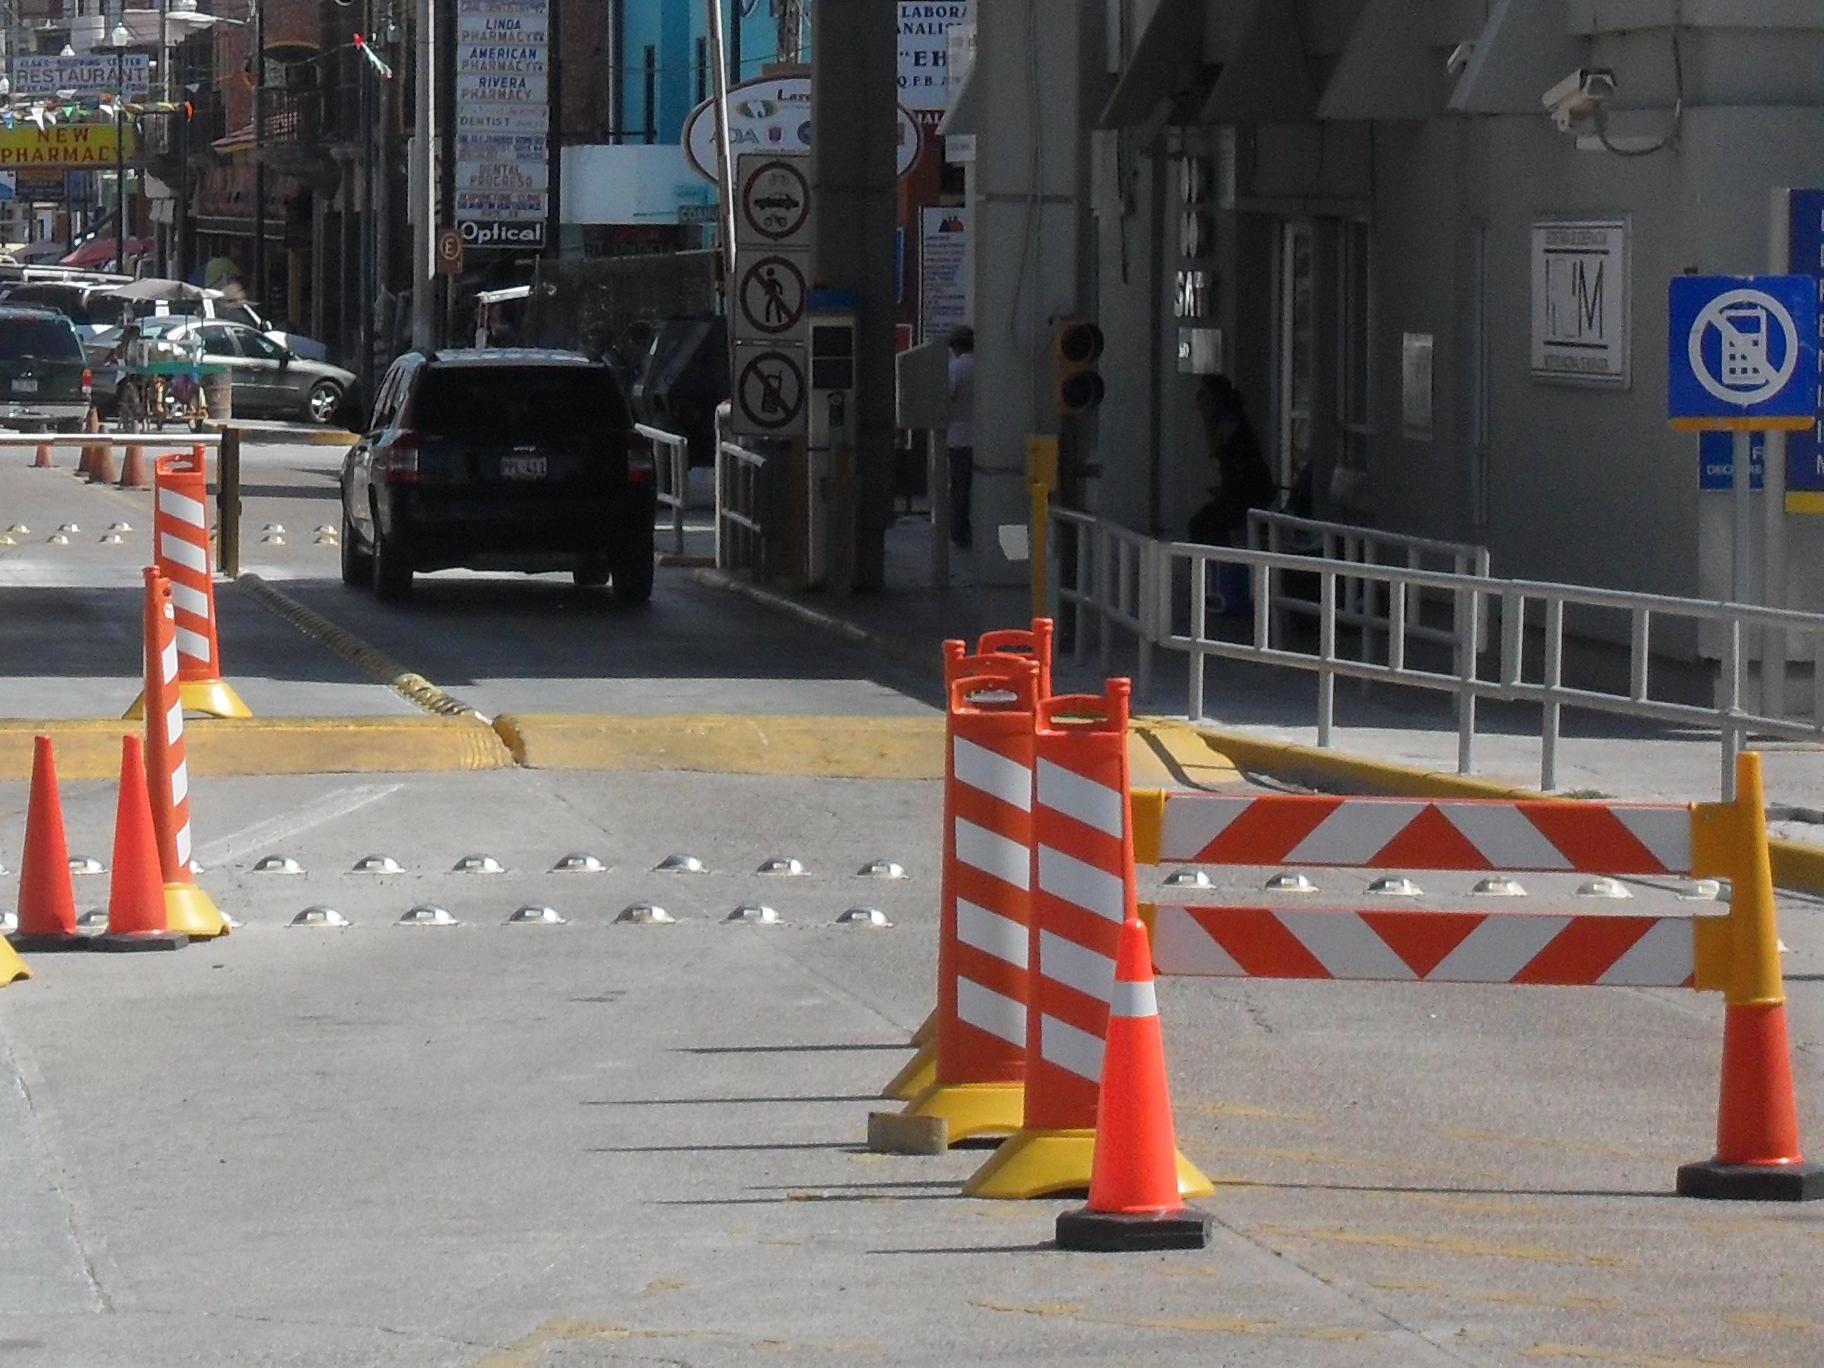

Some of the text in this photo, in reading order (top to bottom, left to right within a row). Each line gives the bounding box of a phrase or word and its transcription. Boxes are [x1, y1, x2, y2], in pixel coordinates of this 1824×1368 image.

[485, 18, 522, 31] LINDA
[461, 31, 532, 42] PHARMACY
[469, 47, 537, 59] AMERICAN
[461, 61, 532, 72] PHARMACY
[16, 67, 145, 83] RESTAURANT
[478, 77, 527, 89] RIVERA
[460, 88, 532, 100] PHARMACY
[37, 127, 89, 143] NEW
[460, 221, 541, 244] Optical
